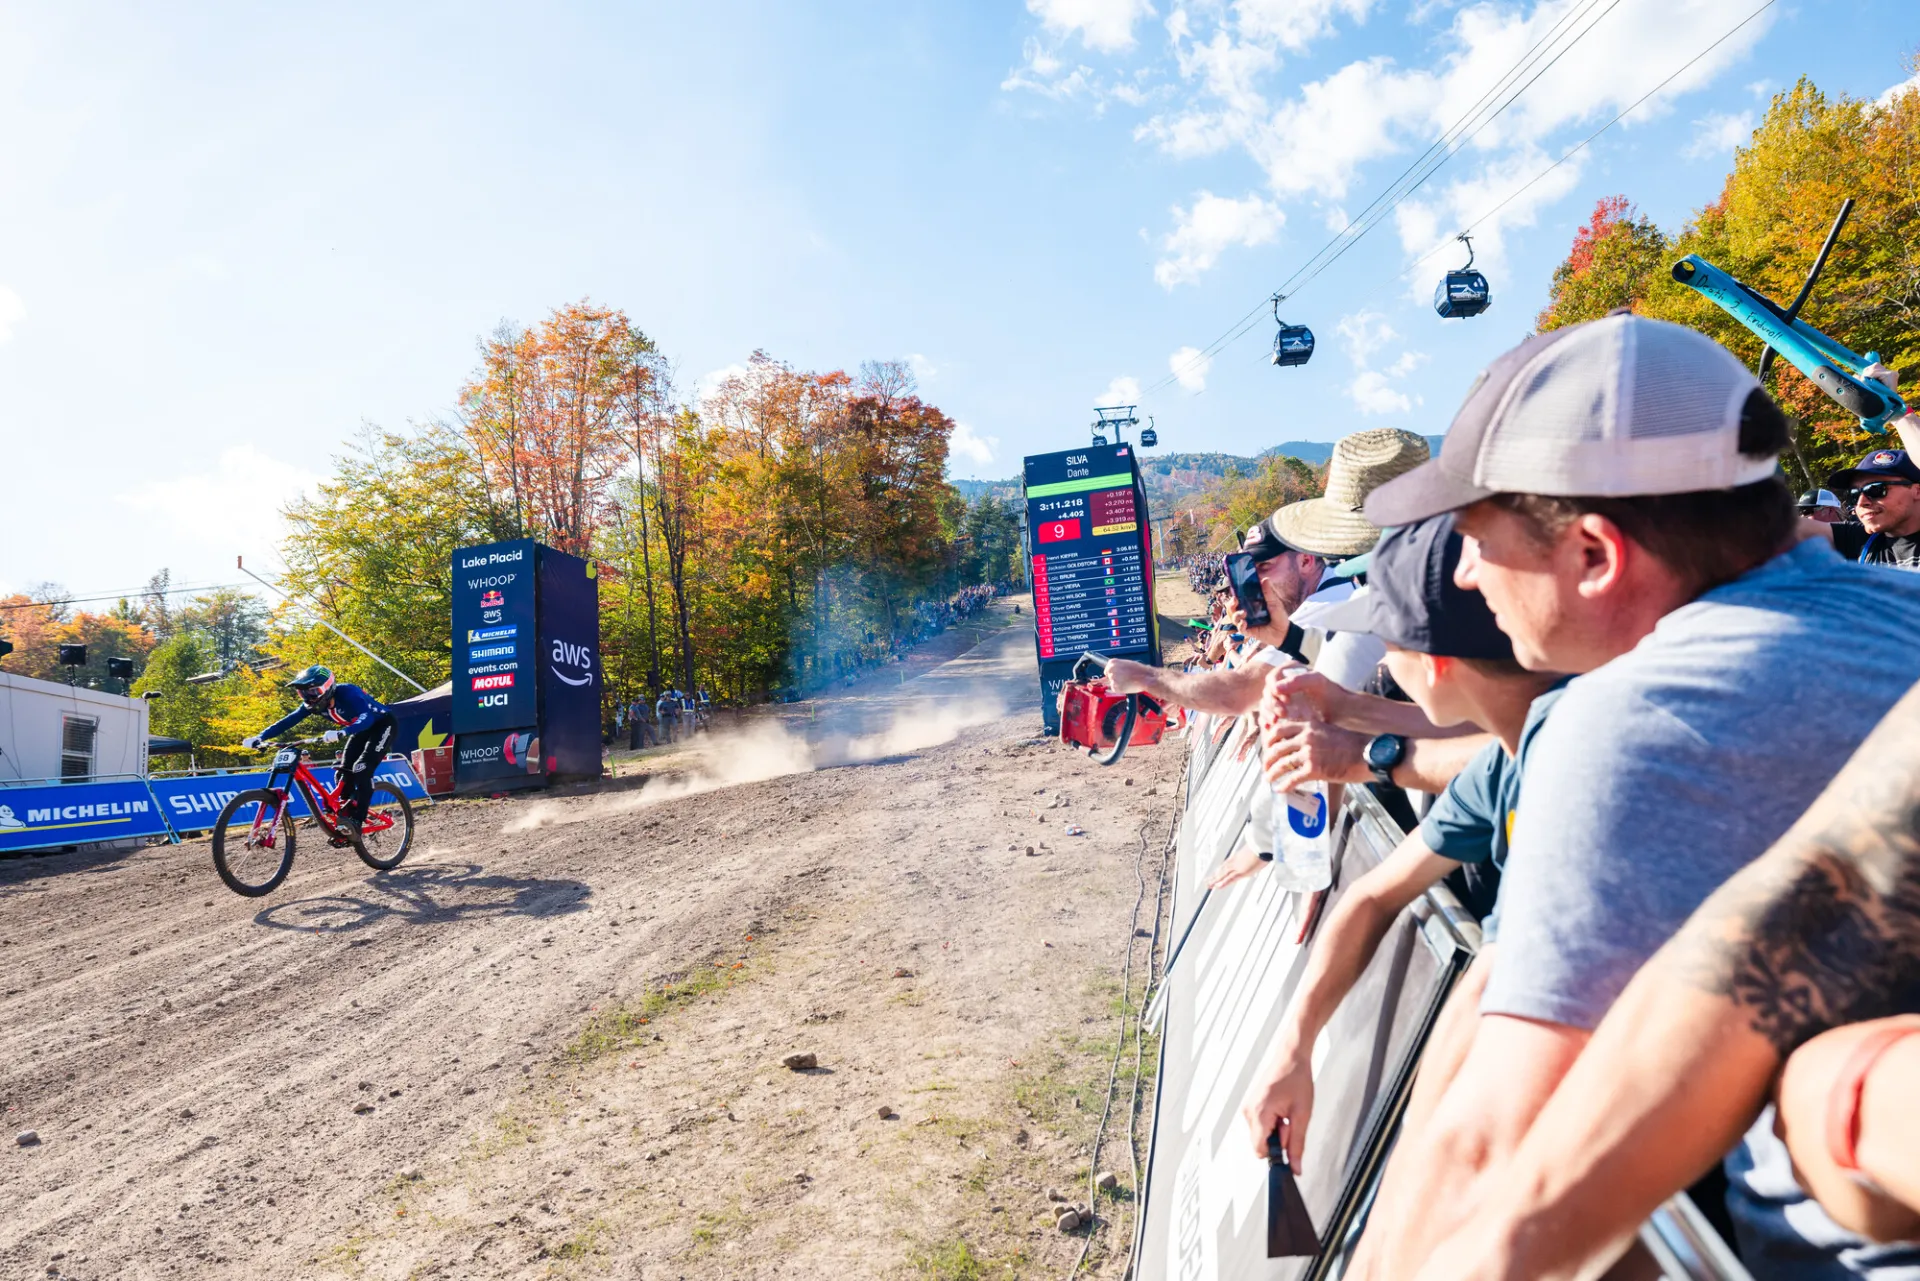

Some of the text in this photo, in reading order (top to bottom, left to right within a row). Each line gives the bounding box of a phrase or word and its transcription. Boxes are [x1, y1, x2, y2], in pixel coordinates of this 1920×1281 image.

[1066, 455, 1088, 466] SILVA
[1067, 468, 1089, 478] Dante
[1040, 499, 1083, 511] 3:11.218
[1058, 510, 1084, 519] +4.402
[1054, 524, 1064, 538] 9
[462, 550, 523, 568] Lake Placid
[468, 574, 516, 590] WHOOP
[484, 609, 502, 619] aws
[482, 629, 517, 638] MICHELIN
[472, 646, 514, 659] SHIMANO
[552, 640, 591, 669] aws
[468, 662, 518, 675] events.com
[474, 675, 512, 690] MOTUL
[484, 694, 508, 707] UCI
[460, 746, 500, 760] WHOOP
[169, 788, 295, 814] SHIM
[28, 800, 149, 822] MICHELIN
